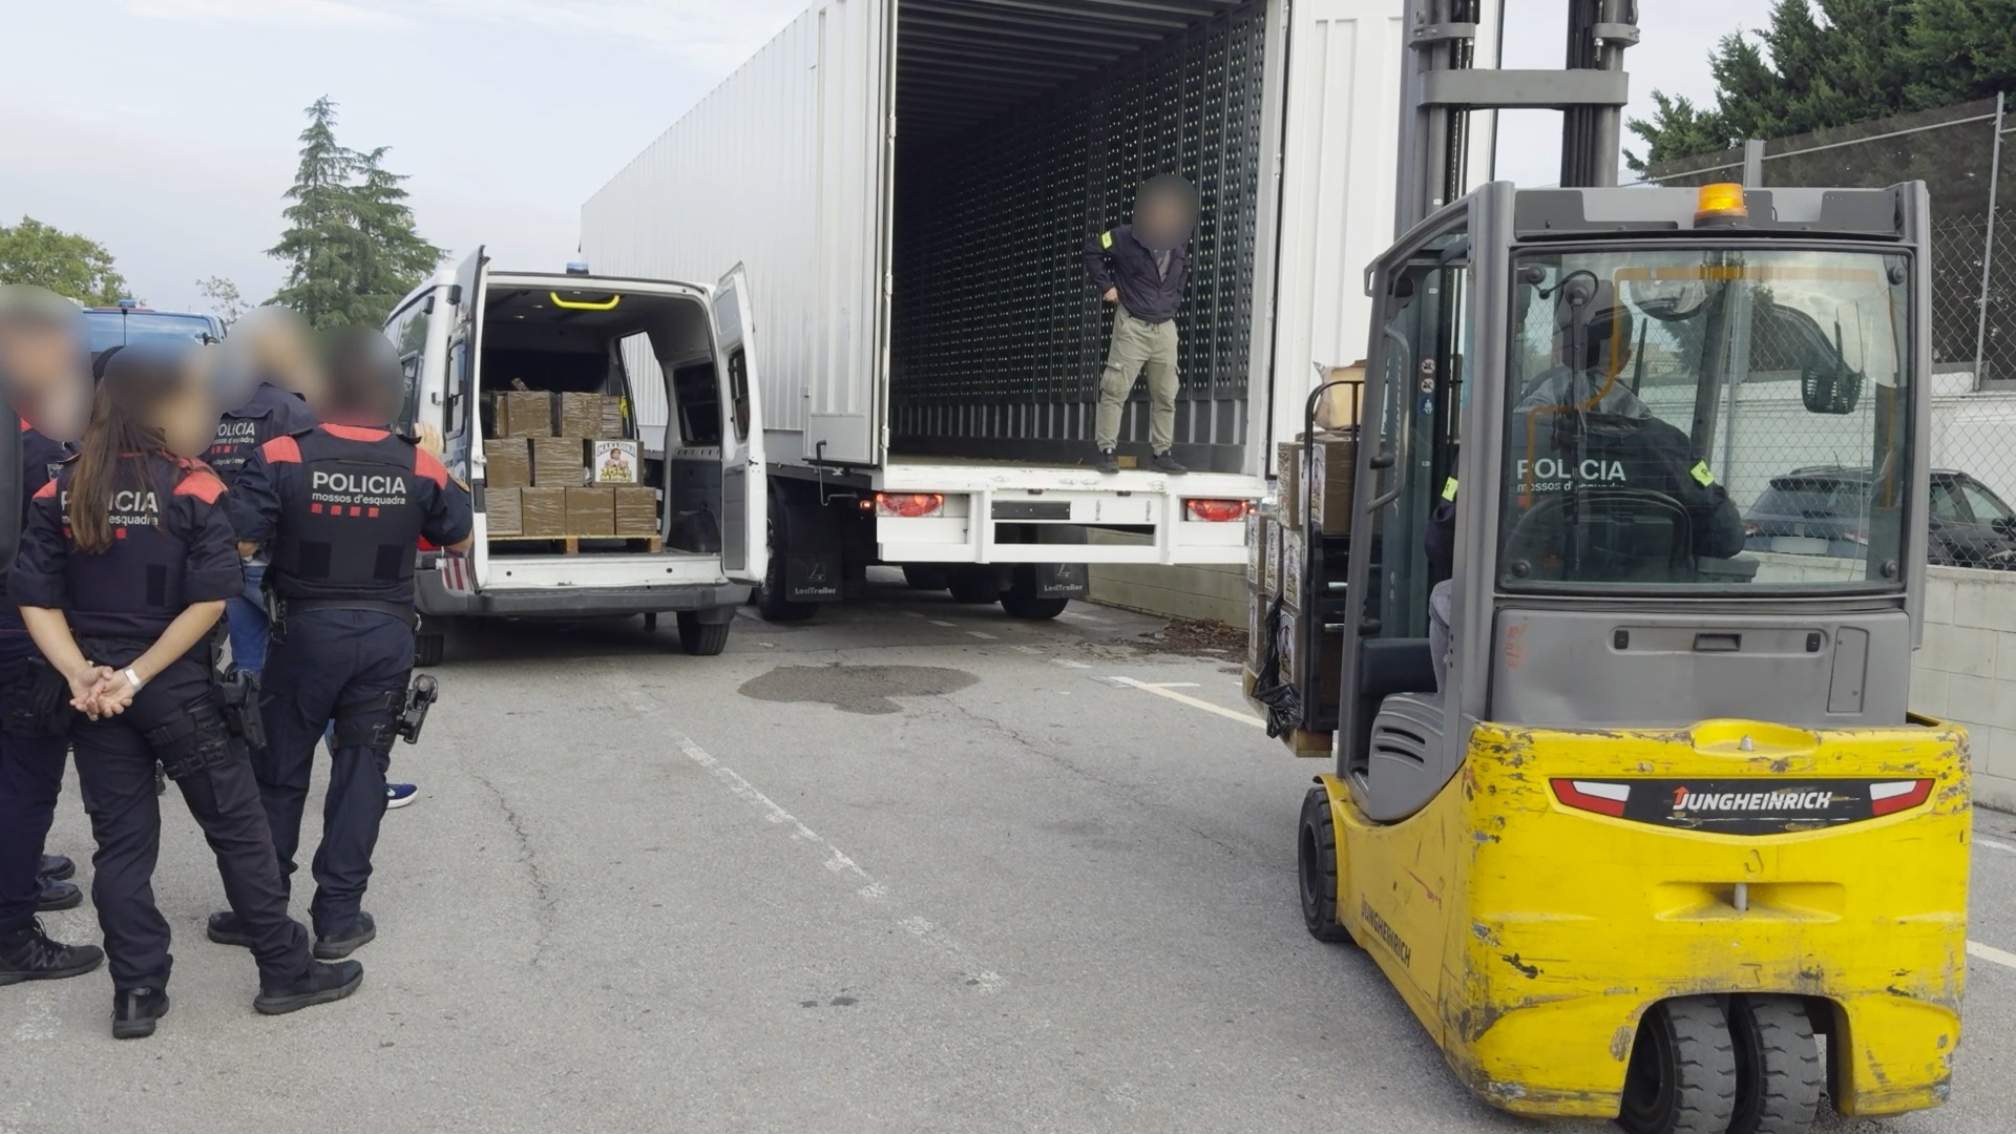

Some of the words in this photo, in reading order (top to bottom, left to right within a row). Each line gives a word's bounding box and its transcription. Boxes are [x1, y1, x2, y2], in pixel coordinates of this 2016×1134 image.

[217, 422, 255, 437] OLICIA
[313, 471, 407, 494] POLICIA
[61, 490, 159, 512] PICIA
[312, 493, 351, 503] mossos
[354, 495, 406, 506] d'esquadra
[108, 514, 159, 527] esquadra
[1673, 790, 1832, 811] JUNGHEINRICH
